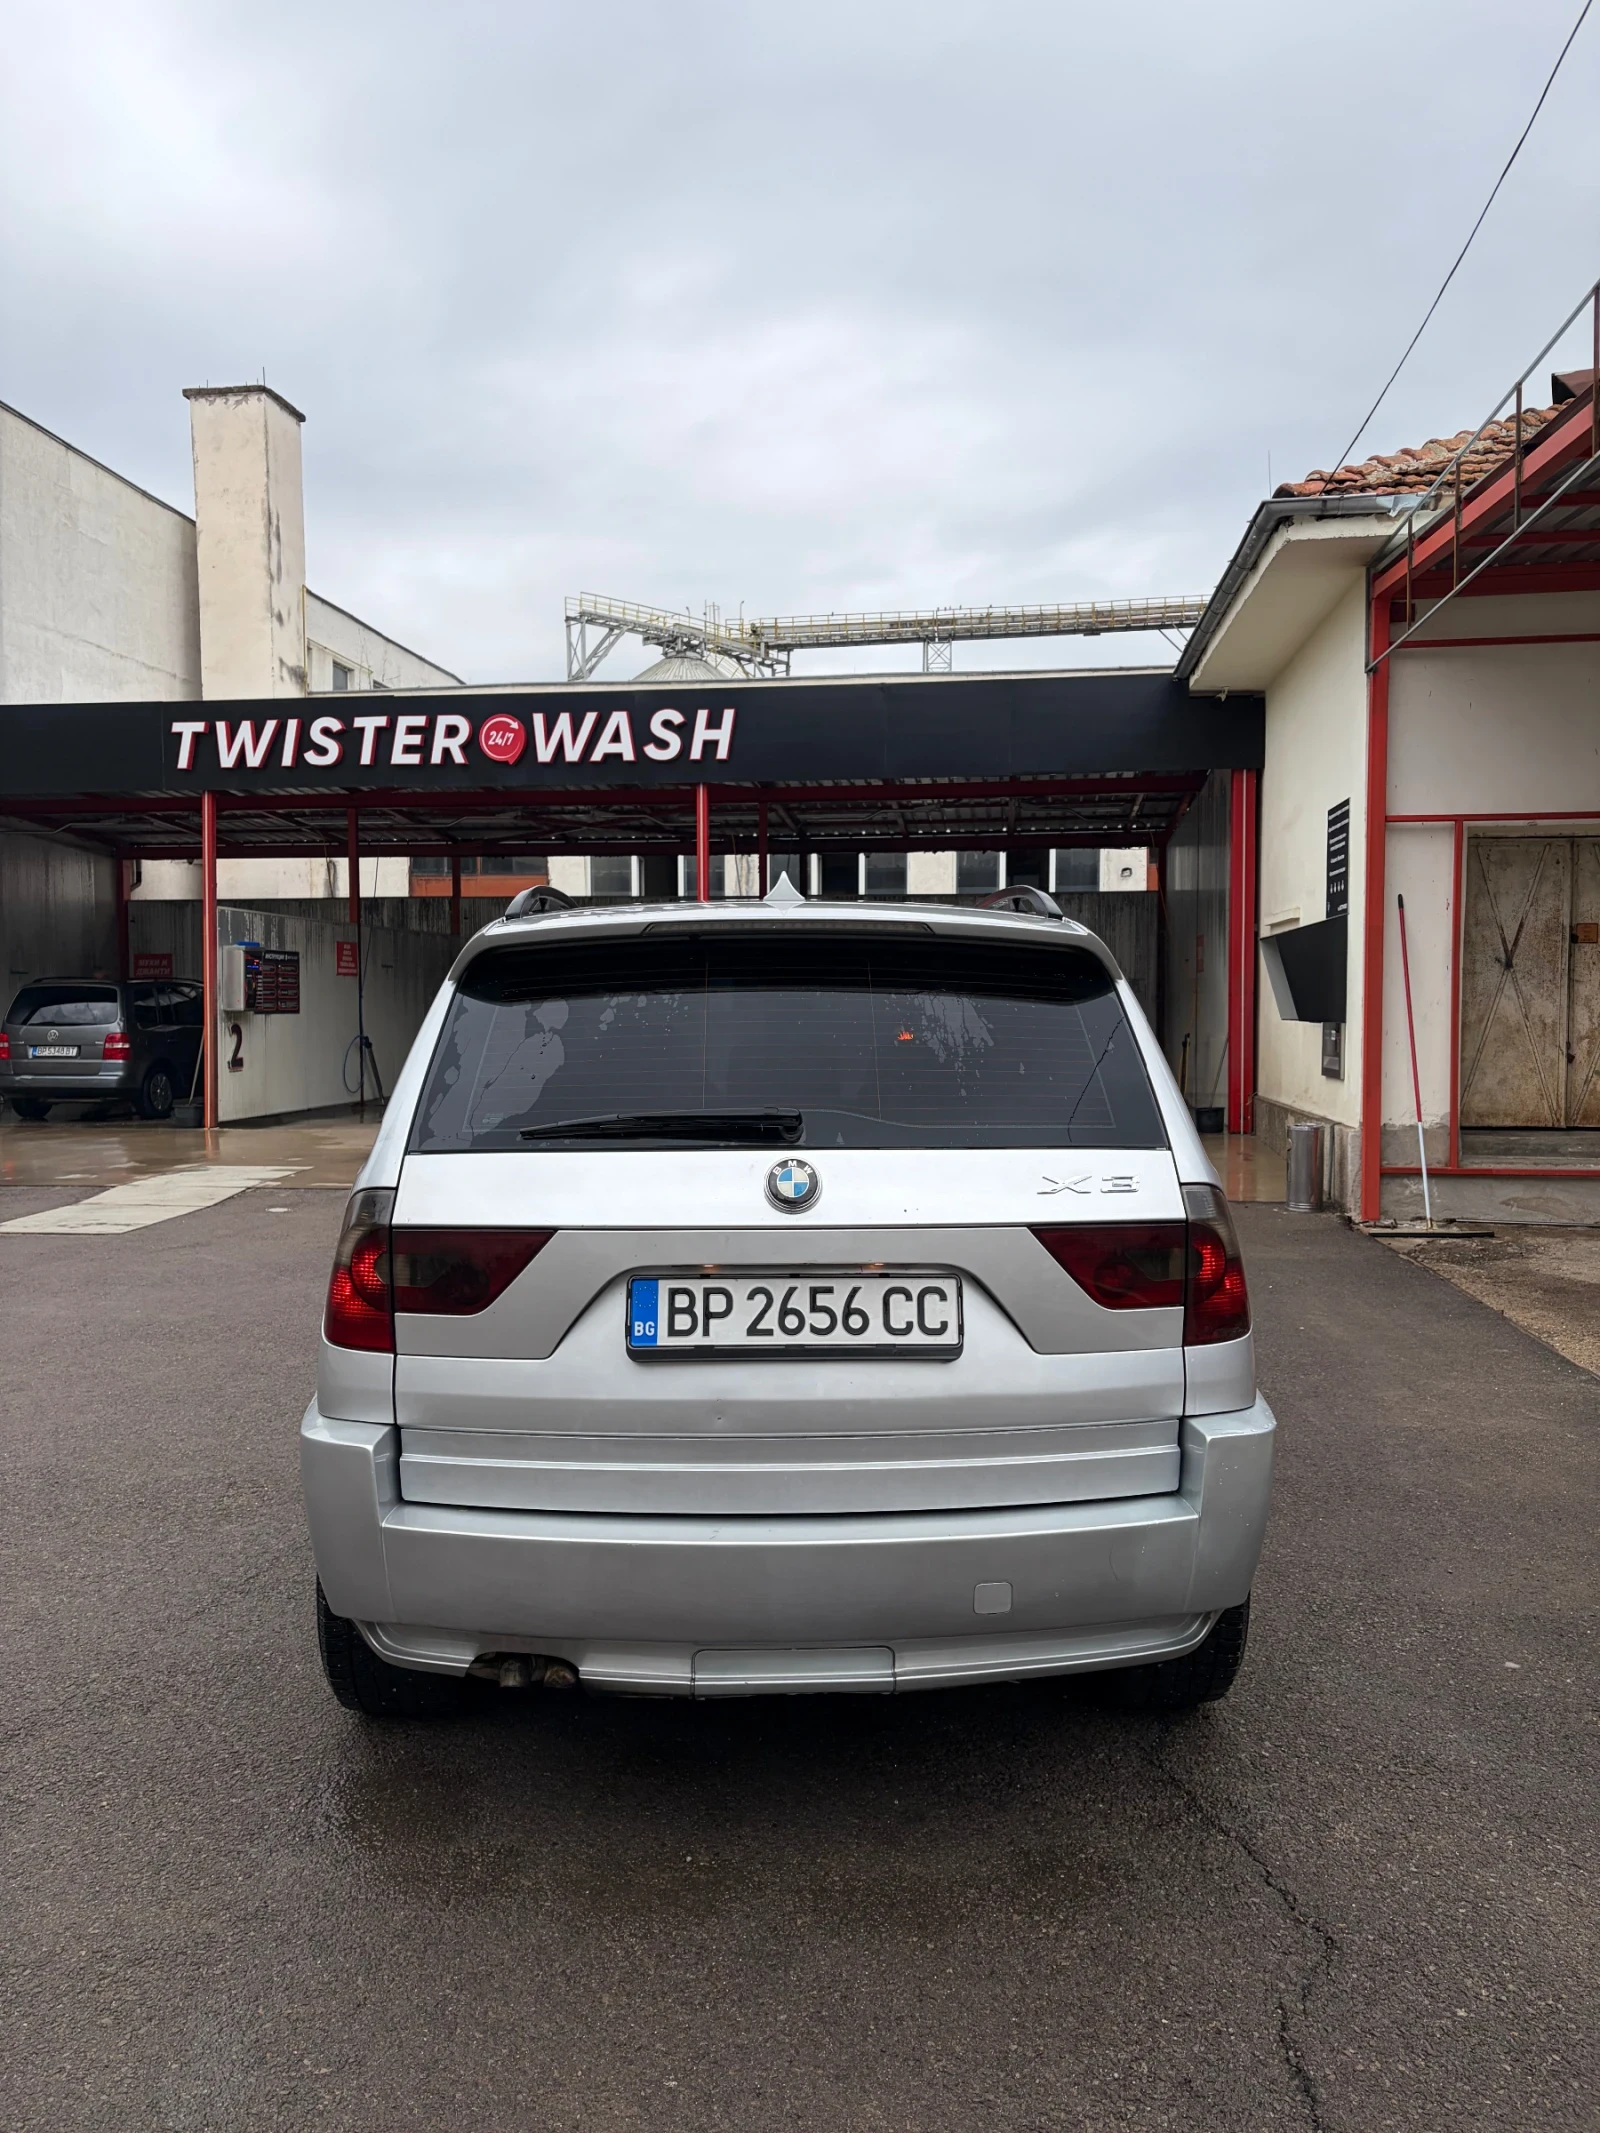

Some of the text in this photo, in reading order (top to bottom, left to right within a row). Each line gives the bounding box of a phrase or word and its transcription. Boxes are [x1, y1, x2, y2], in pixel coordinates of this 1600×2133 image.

[169, 707, 736, 770] TWISTER 24/7 WASH
[227, 1023, 244, 1071] 2
[772, 1159, 814, 1176] BMW
[1036, 1174, 1141, 1195] X3
[666, 1286, 949, 1337] BP 2656 CC
[633, 1321, 655, 1337] BG
